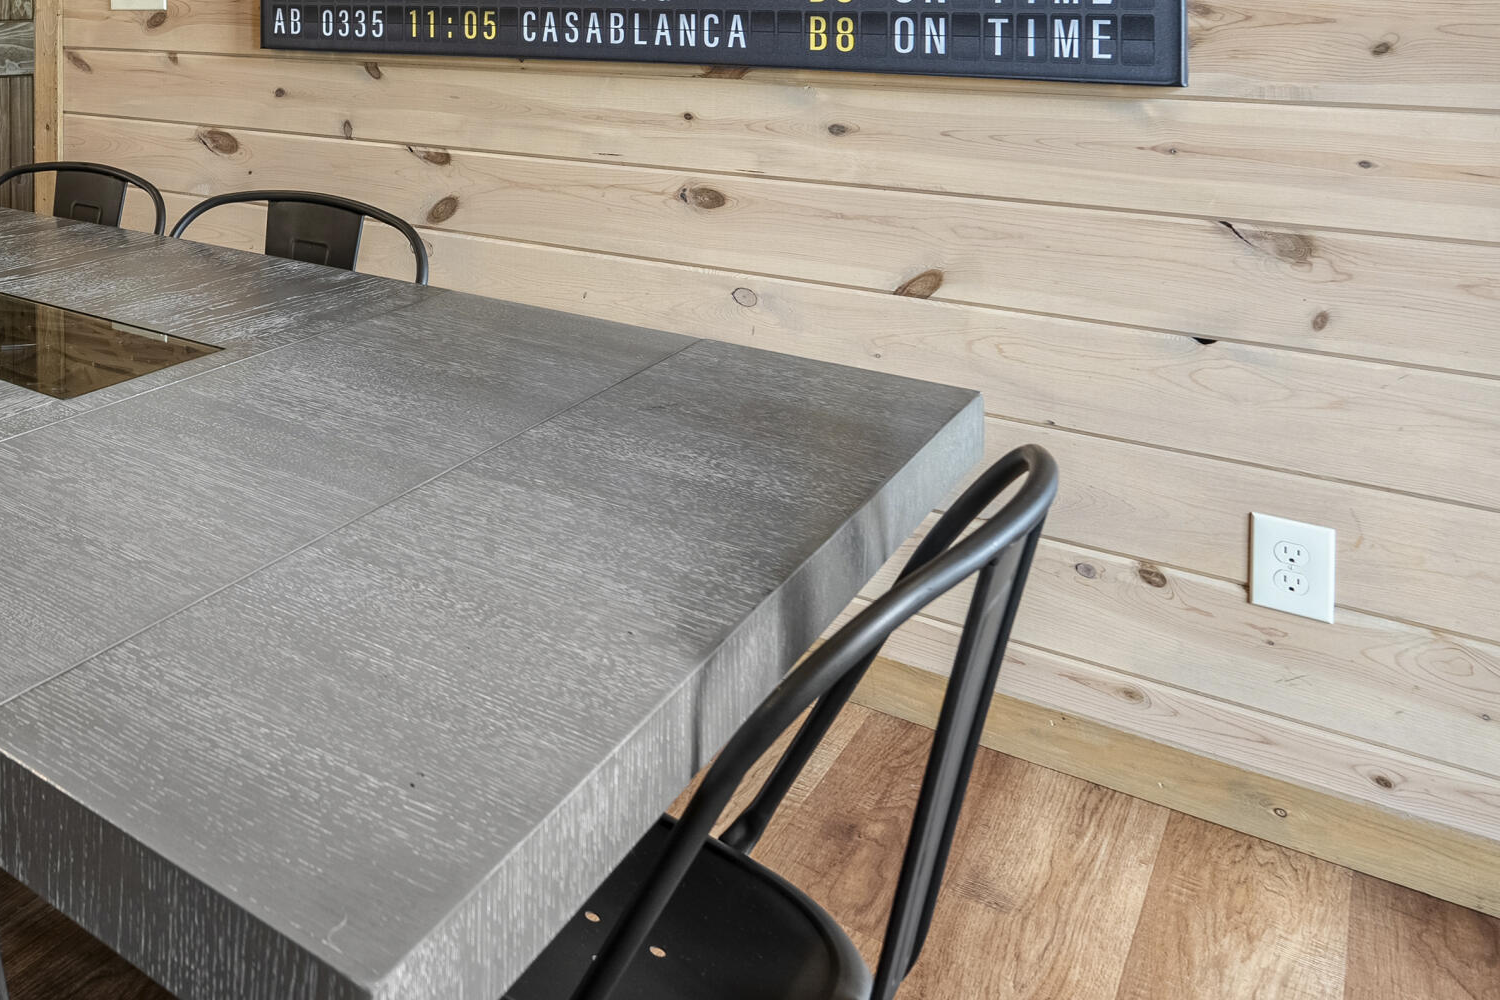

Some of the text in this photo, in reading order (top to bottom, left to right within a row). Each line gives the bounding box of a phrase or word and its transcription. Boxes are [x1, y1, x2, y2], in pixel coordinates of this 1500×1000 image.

[274, 8, 1112, 59] AB 0335 11:05 CASABLANCA B8 ON TIME
